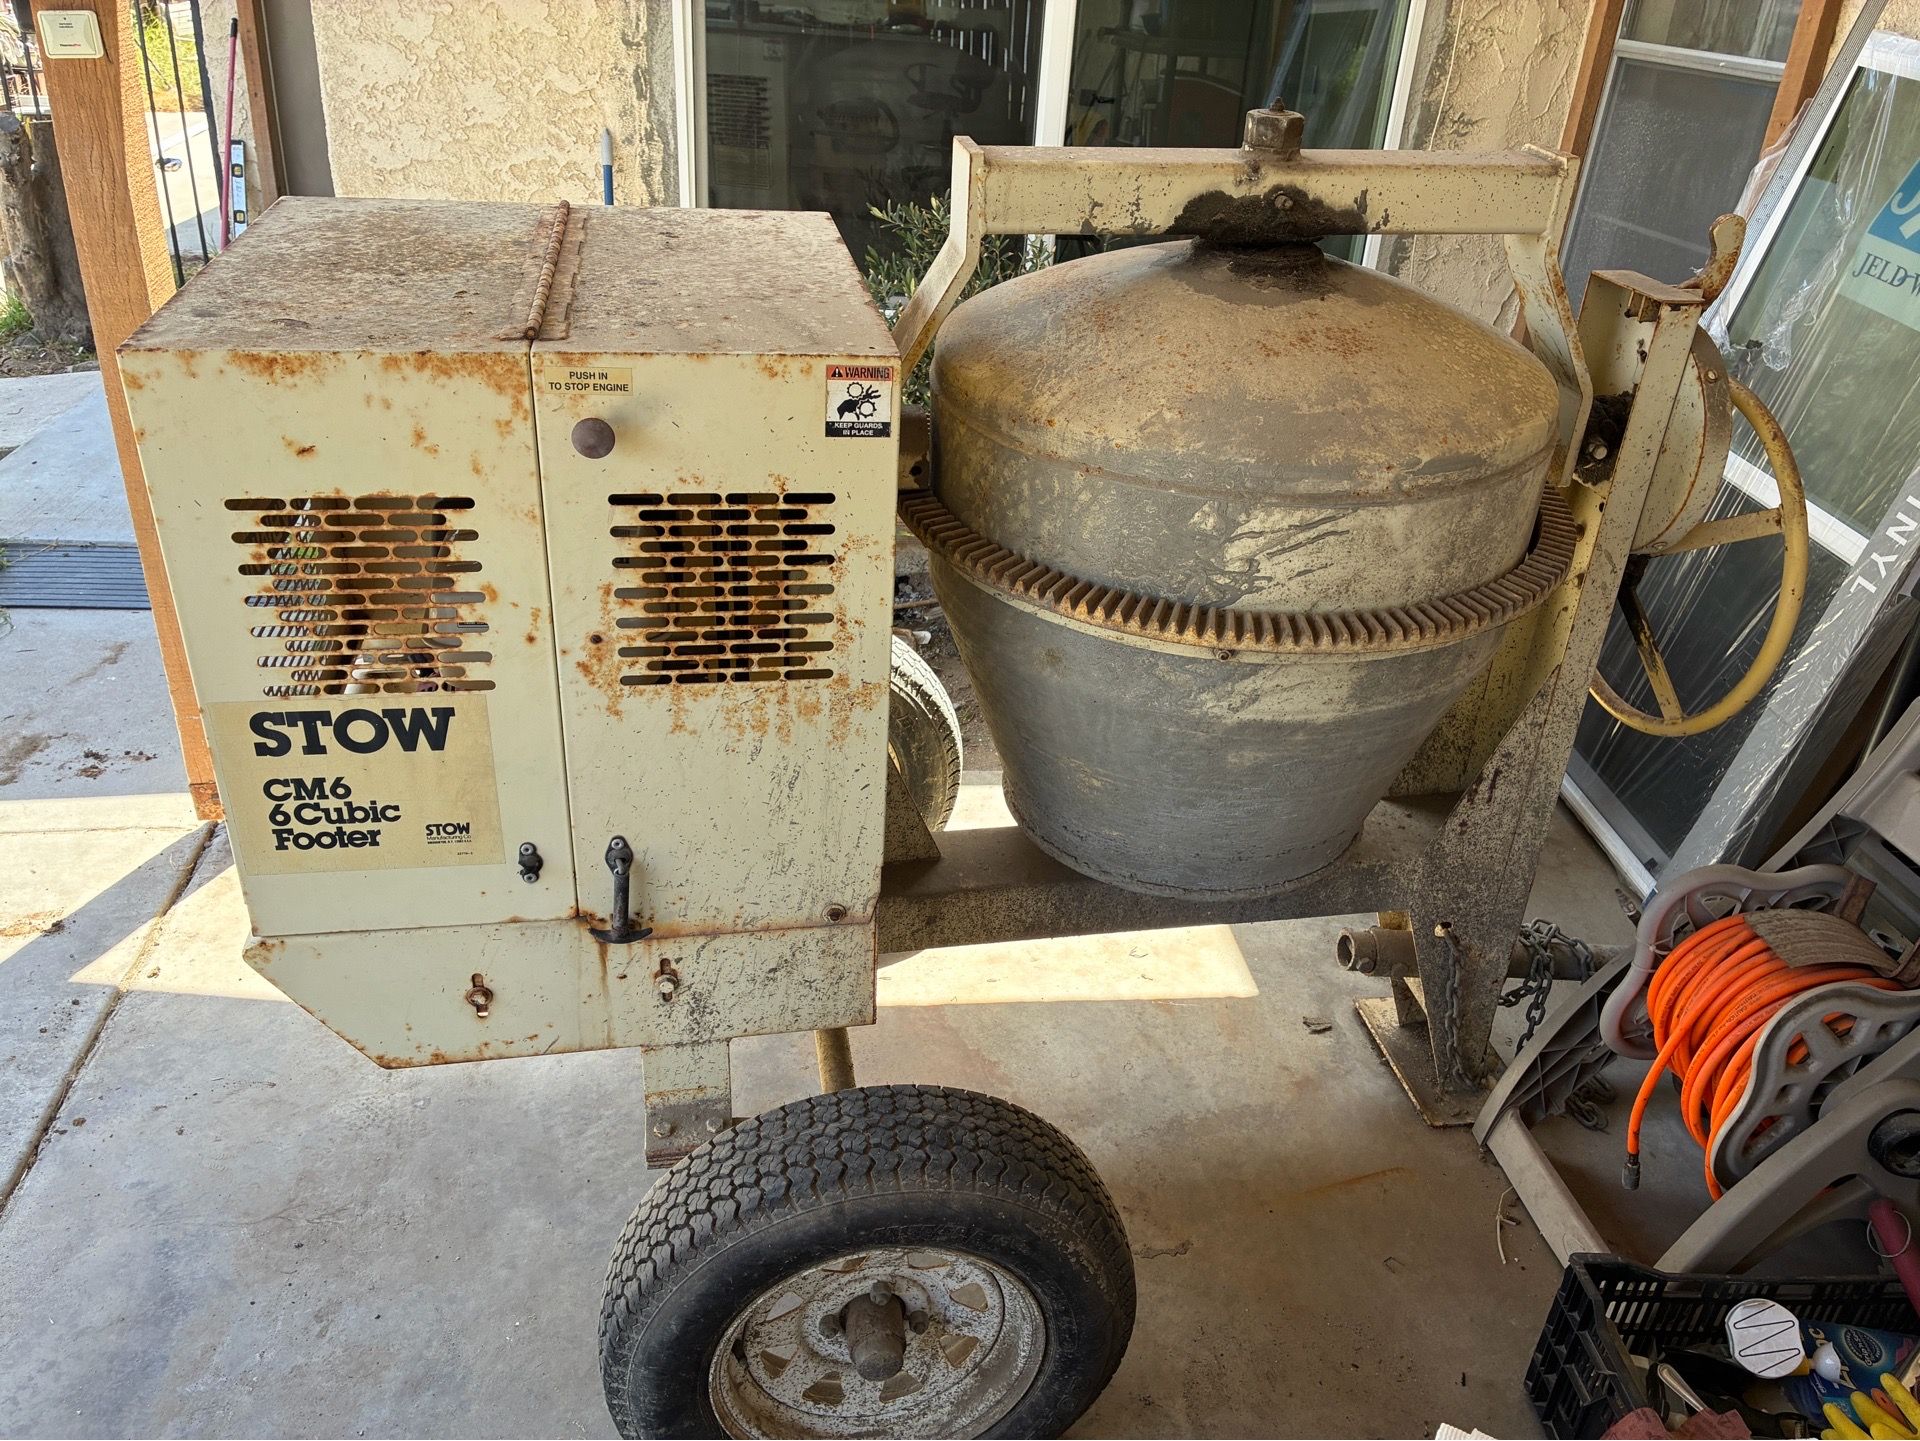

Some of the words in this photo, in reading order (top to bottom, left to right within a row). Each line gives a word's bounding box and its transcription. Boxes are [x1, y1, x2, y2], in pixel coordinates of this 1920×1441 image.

[569, 371, 596, 380] PUSH
[598, 372, 608, 380] IN
[844, 366, 890, 379] WARNING
[548, 382, 562, 391] TO
[564, 382, 590, 391] STOP
[592, 383, 629, 392] ENGINE
[249, 706, 456, 757] STOW
[263, 776, 352, 802] CM6
[268, 803, 291, 827] 6
[293, 800, 402, 826] Cubic
[272, 826, 381, 851] Footer
[425, 822, 470, 836] STOW
